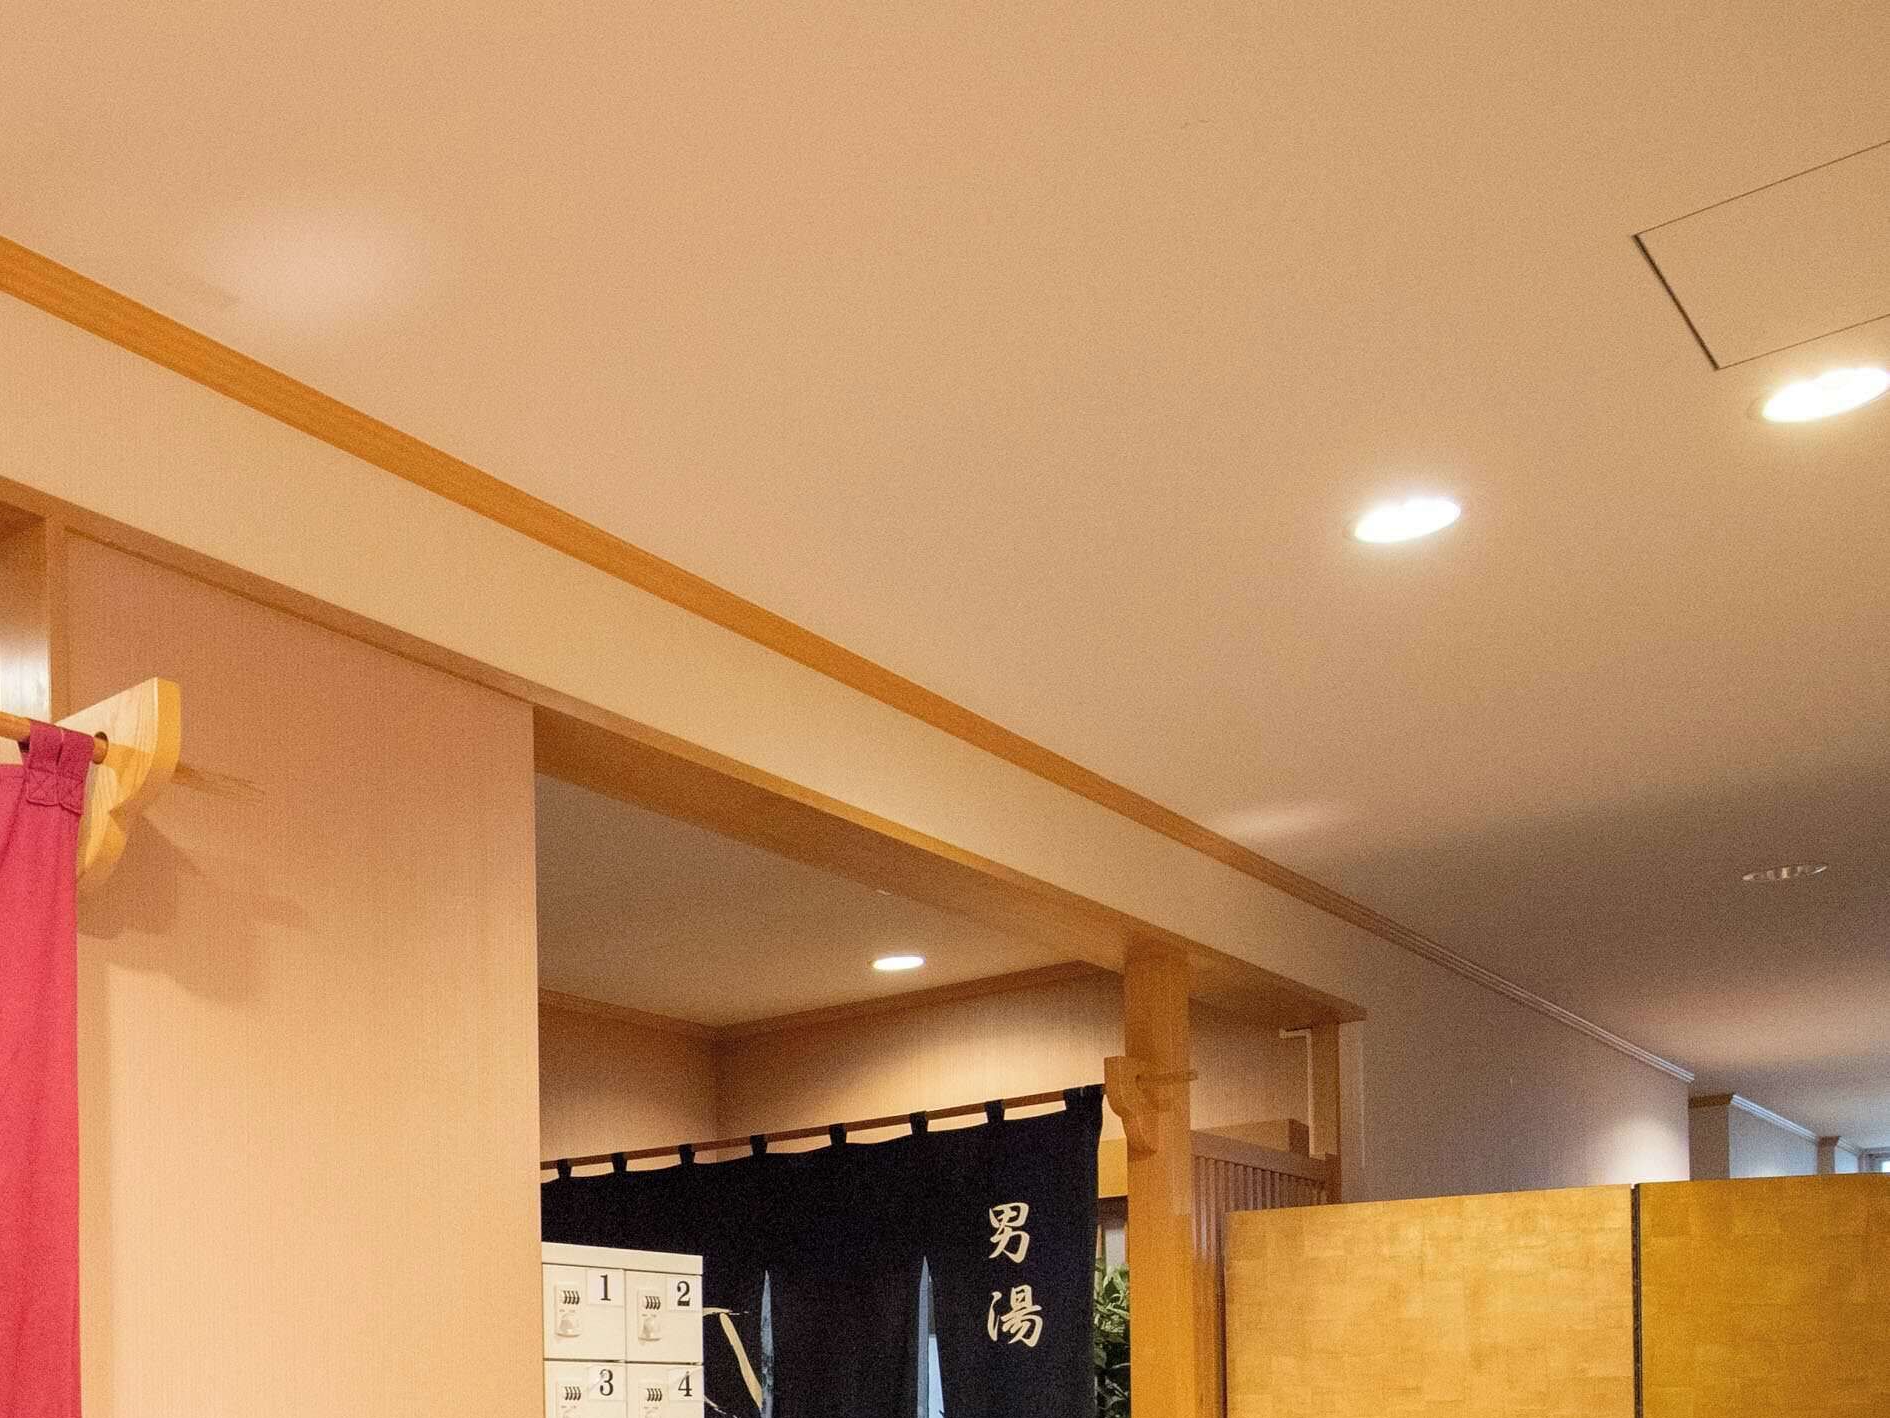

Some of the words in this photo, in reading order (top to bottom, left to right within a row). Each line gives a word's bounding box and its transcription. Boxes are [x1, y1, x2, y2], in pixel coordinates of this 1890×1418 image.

[599, 1274, 612, 1301] 1
[987, 1202, 1044, 1348] 男湯
[676, 1281, 691, 1307] 2
[599, 1368, 614, 1397] 3
[677, 1371, 693, 1397] 4
